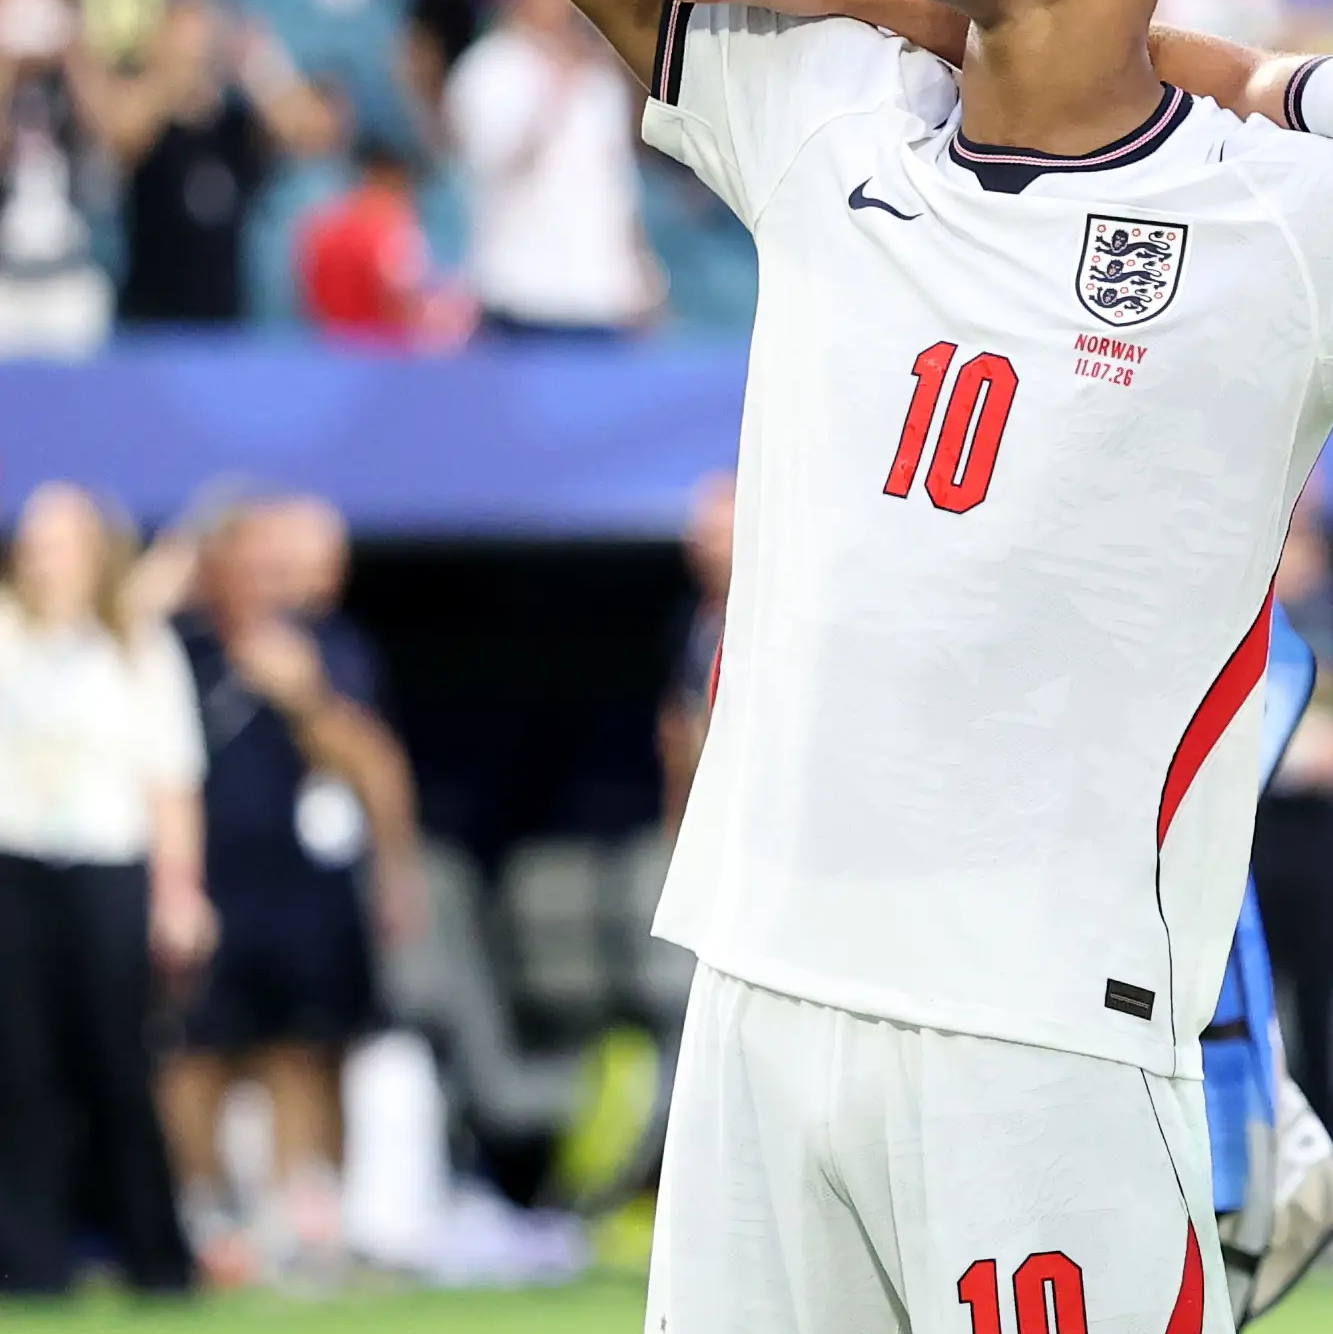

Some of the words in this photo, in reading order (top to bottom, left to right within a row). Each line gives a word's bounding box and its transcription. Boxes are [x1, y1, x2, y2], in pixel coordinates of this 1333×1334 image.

[1074, 333, 1148, 364] NORWAY
[1074, 358, 1134, 386] 11.07.26
[883, 340, 1018, 515] 10
